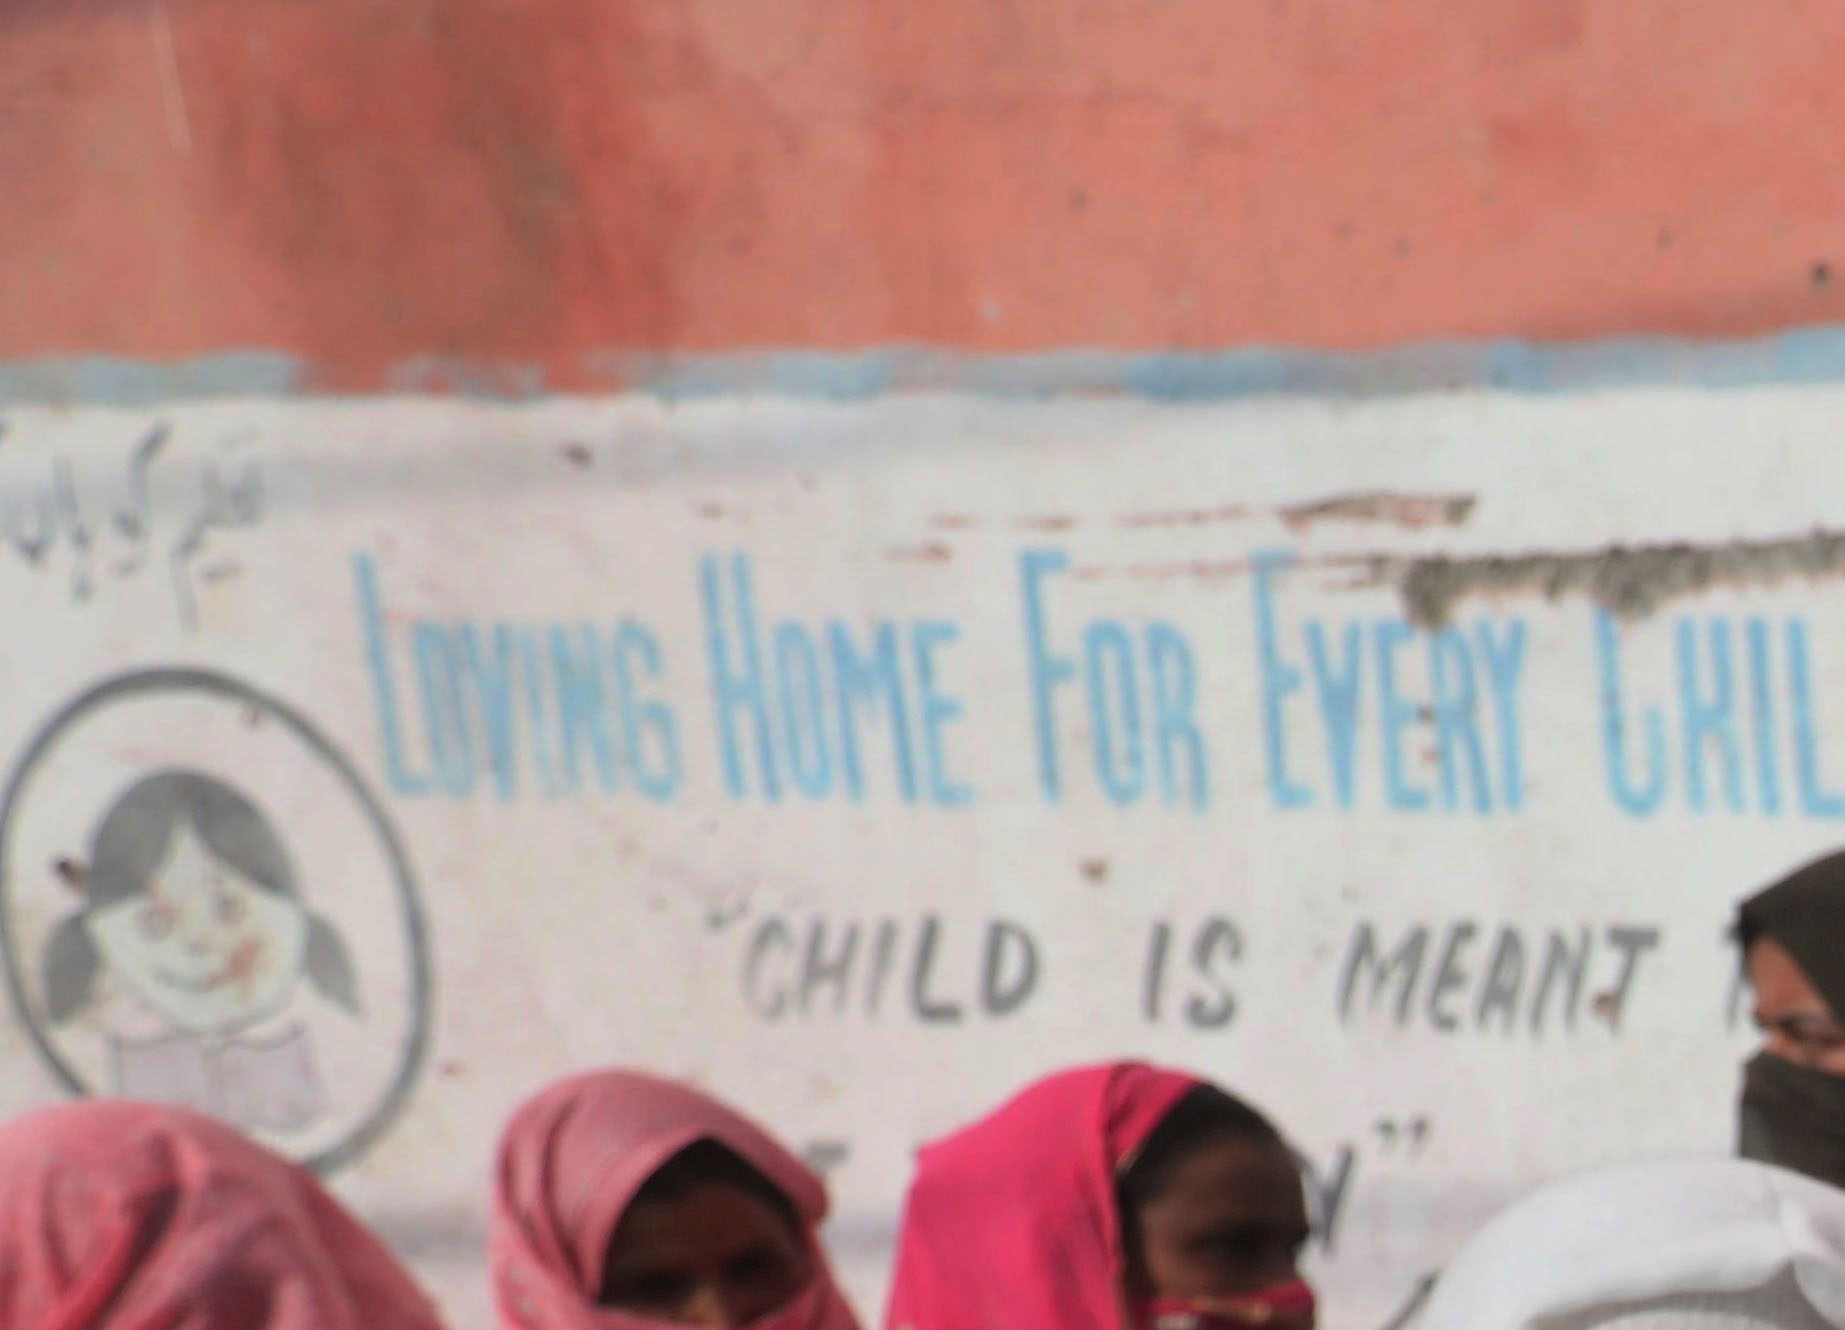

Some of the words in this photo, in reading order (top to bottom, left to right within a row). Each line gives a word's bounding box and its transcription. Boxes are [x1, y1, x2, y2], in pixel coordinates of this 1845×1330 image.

[350, 550, 684, 800] LOVING
[698, 551, 978, 804] HOME
[1016, 549, 1212, 808] FOR
[1250, 549, 1528, 814] EVERY
[1140, 916, 1246, 1030] IS
[1336, 916, 1662, 1036] MEANT
